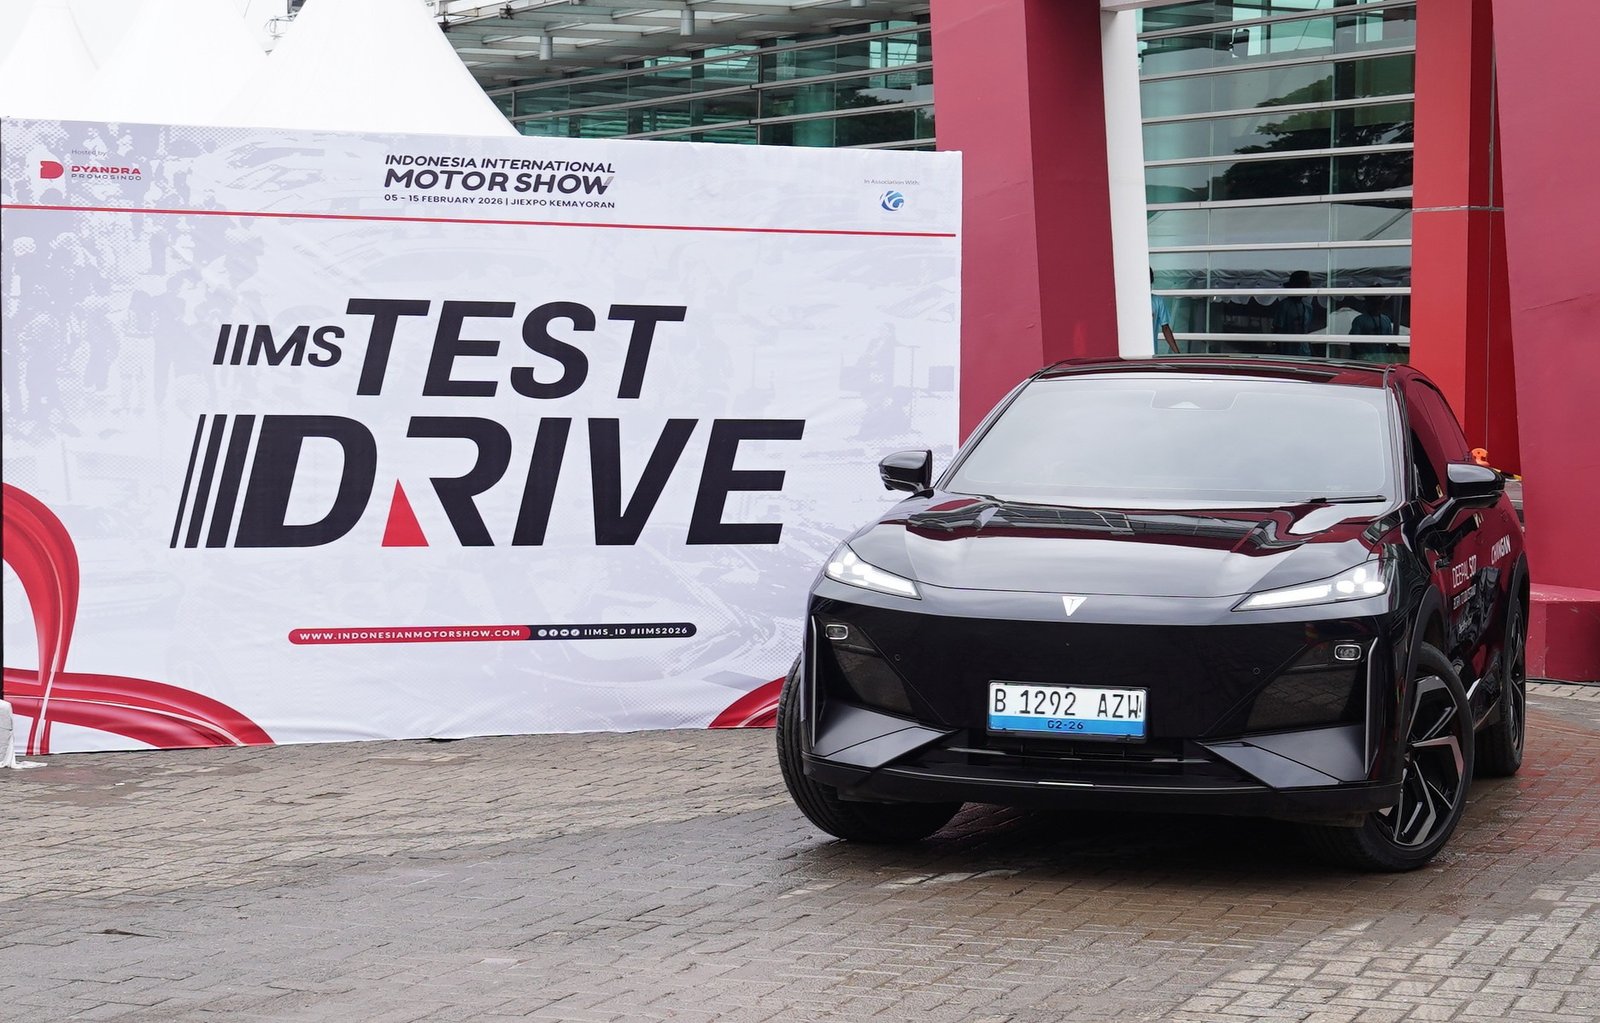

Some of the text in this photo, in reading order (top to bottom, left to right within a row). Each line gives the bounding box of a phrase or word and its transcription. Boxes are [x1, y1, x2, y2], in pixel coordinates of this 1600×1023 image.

[71, 165, 141, 174] DYANDRA
[385, 154, 615, 173] INDONESIA INTERNATIONAL
[384, 168, 614, 195] MOTOR SHOW
[384, 193, 398, 202] 05
[408, 194, 420, 203] 15
[421, 195, 476, 205] FEBRUARY
[478, 196, 503, 205] 2026
[511, 198, 547, 207] JIEXPO
[549, 199, 615, 209] KEMAYORAN
[213, 298, 687, 399] IIMS TEST
[233, 414, 806, 549] DRIVE
[299, 626, 688, 641] WWW.INDONESIANMOTORSHOW.COM IIMS_ID #IIMS2026
[994, 688, 1140, 719] B 1292 AZW
